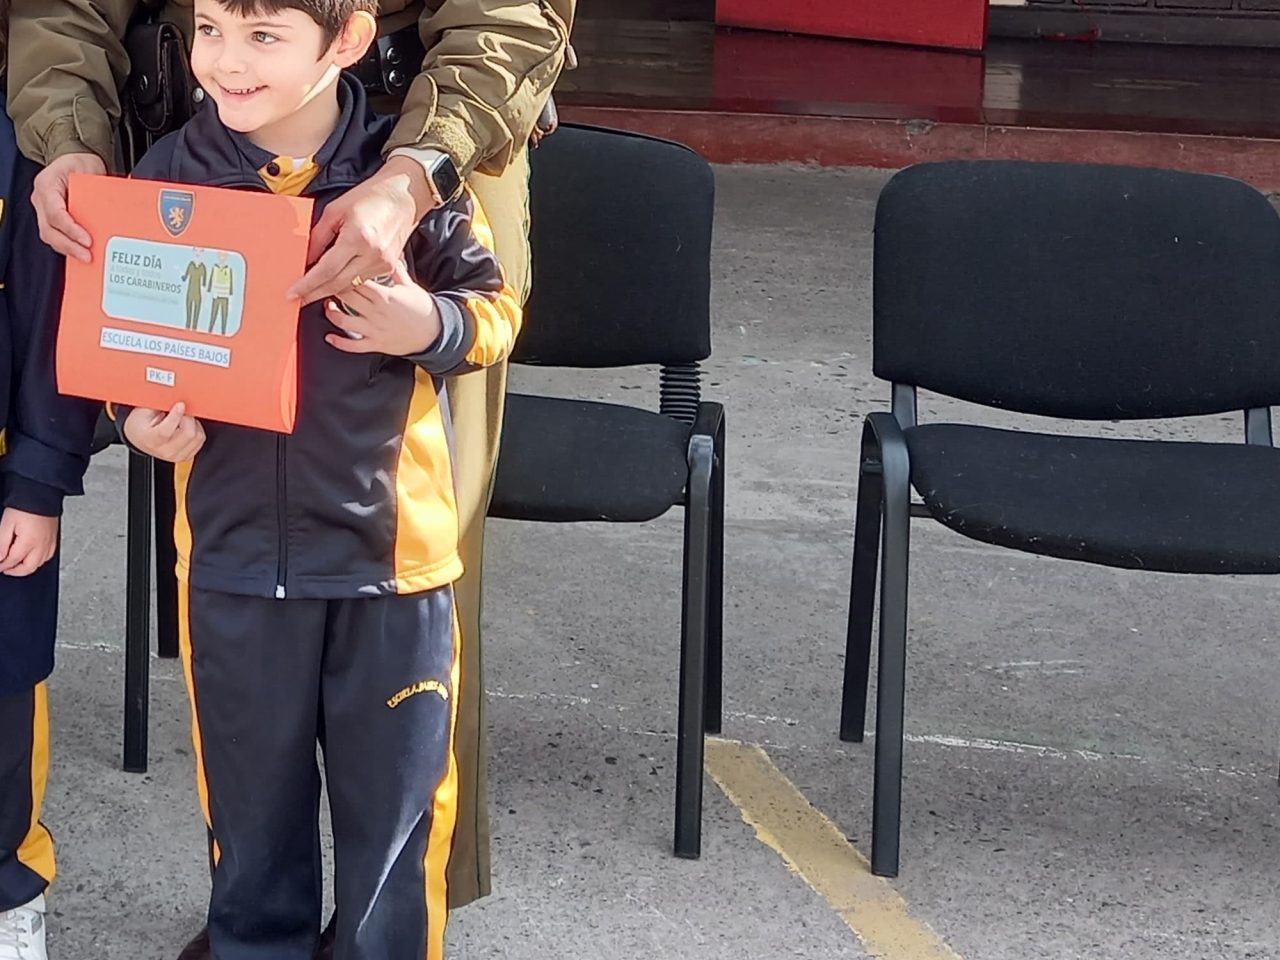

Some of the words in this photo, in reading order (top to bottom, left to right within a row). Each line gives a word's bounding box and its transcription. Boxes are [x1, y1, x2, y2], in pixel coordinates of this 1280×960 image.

[111, 251, 141, 267] FELIZ
[109, 273, 126, 285] LOS
[126, 276, 183, 294] CARABINEROS
[102, 330, 143, 348] ESCUELA
[144, 339, 163, 352] LOS
[164, 342, 197, 358] PAÍSES
[198, 348, 229, 365] BAJOS
